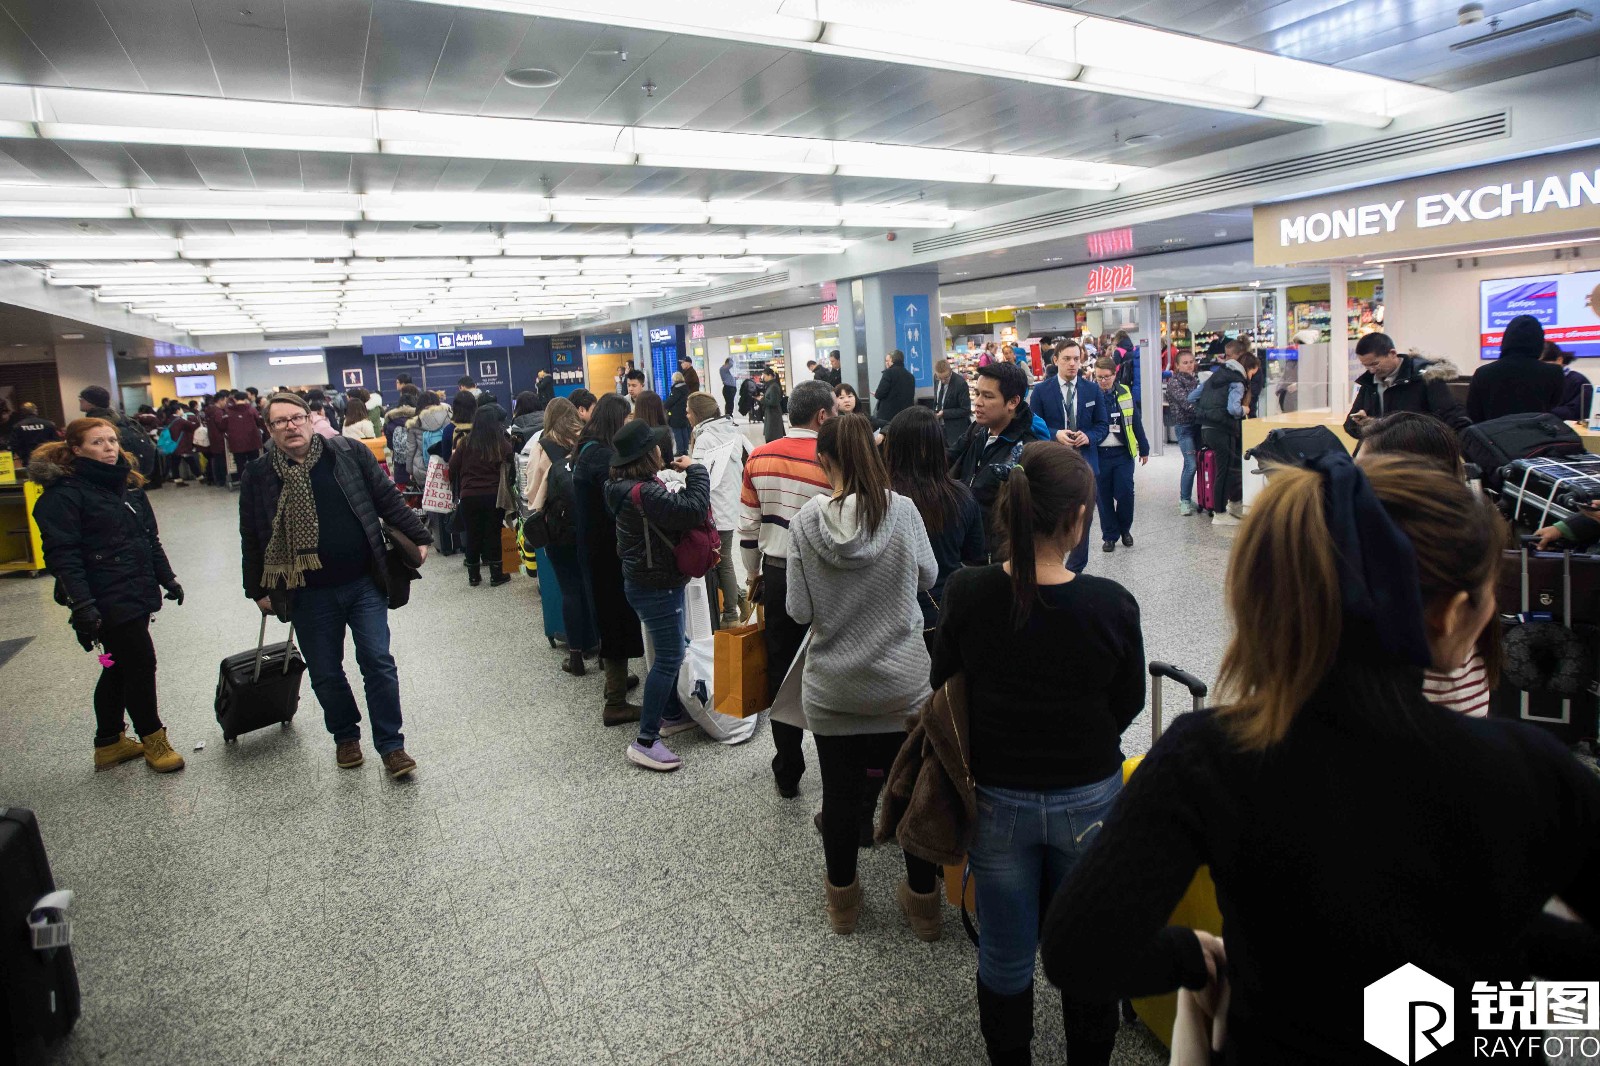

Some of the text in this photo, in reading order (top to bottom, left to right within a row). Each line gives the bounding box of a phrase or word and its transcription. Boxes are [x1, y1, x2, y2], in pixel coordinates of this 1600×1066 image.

[1280, 168, 1600, 246] MONEY EXCHAN
[1086, 264, 1134, 294] alepa
[455, 332, 484, 341] Arrivals
[155, 362, 218, 373] TAX REFUNDS
